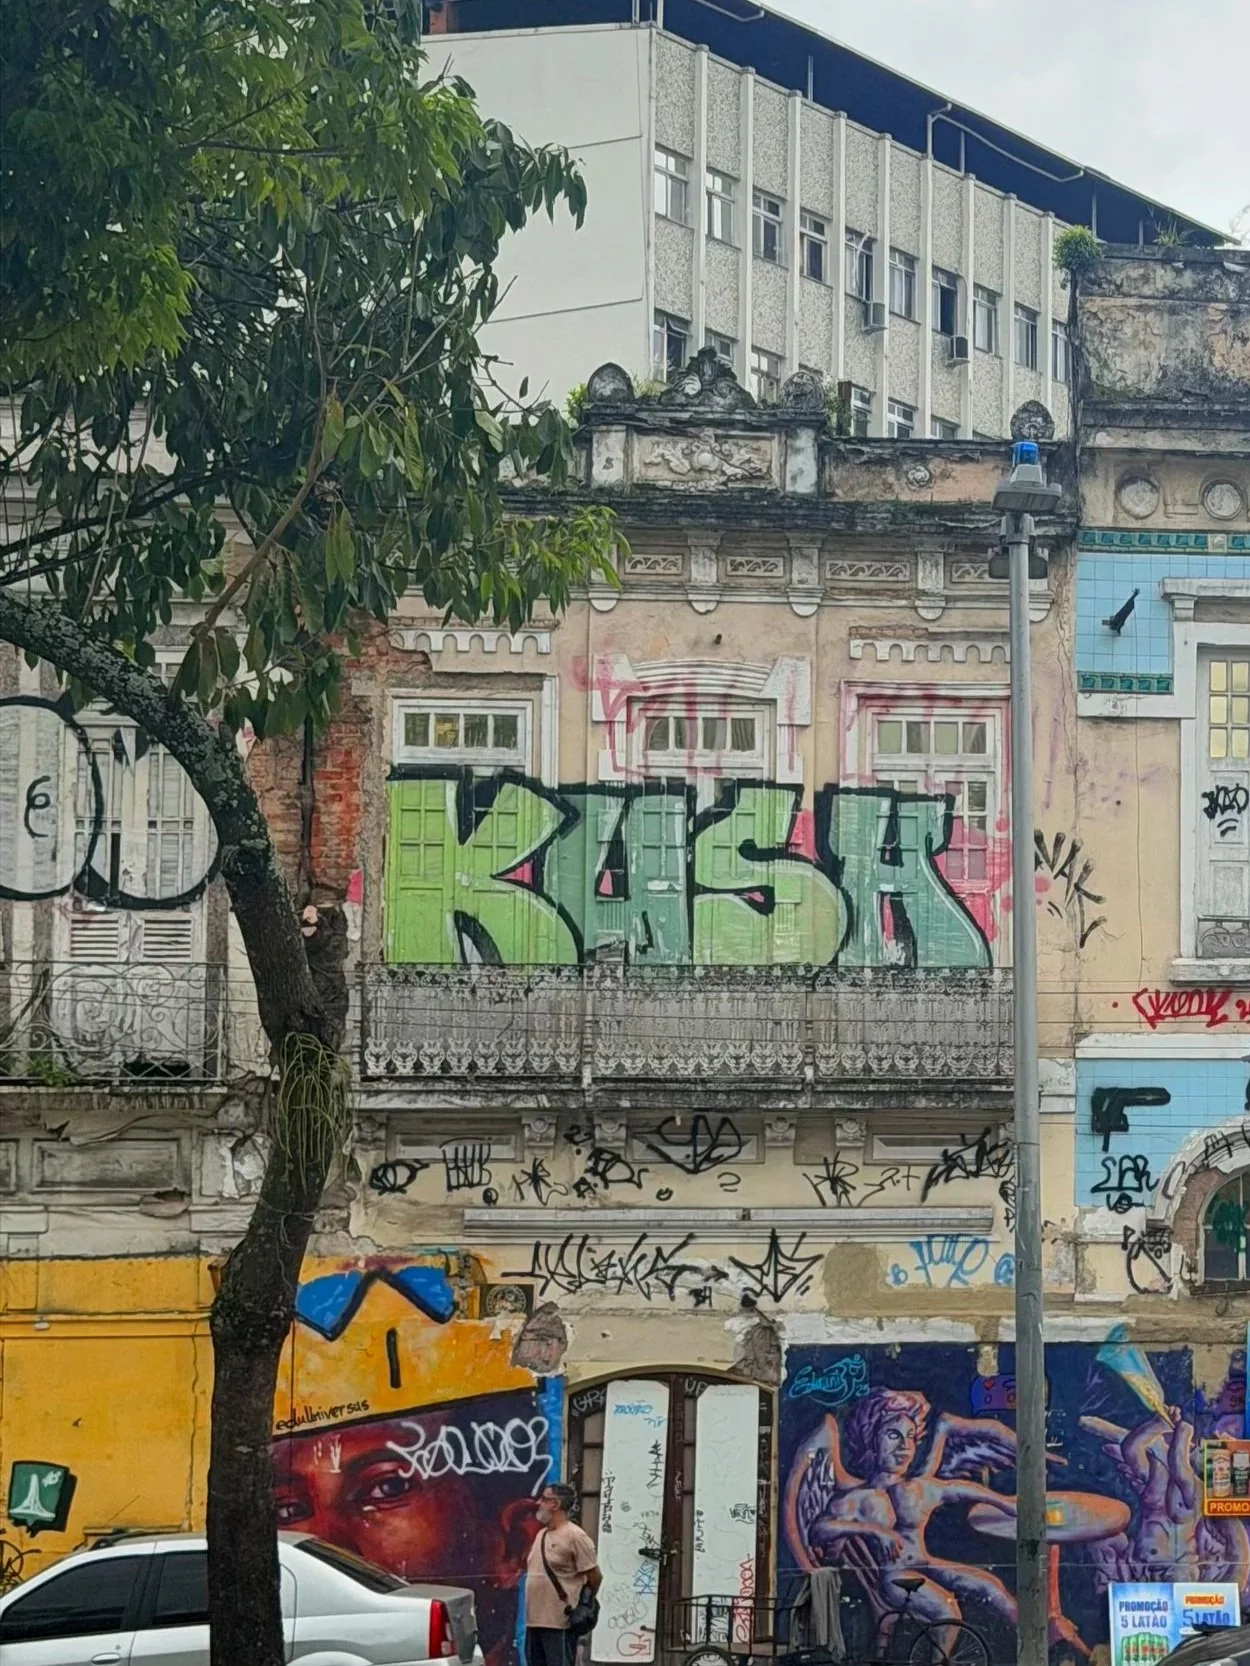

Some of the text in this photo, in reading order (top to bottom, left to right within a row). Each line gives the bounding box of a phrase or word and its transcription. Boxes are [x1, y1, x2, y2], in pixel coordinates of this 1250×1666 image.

[1119, 1599, 1168, 1613] PROMOÇÃO
[1121, 1612, 1168, 1628] 5 LATÃO
[1183, 1609, 1194, 1627] 5
